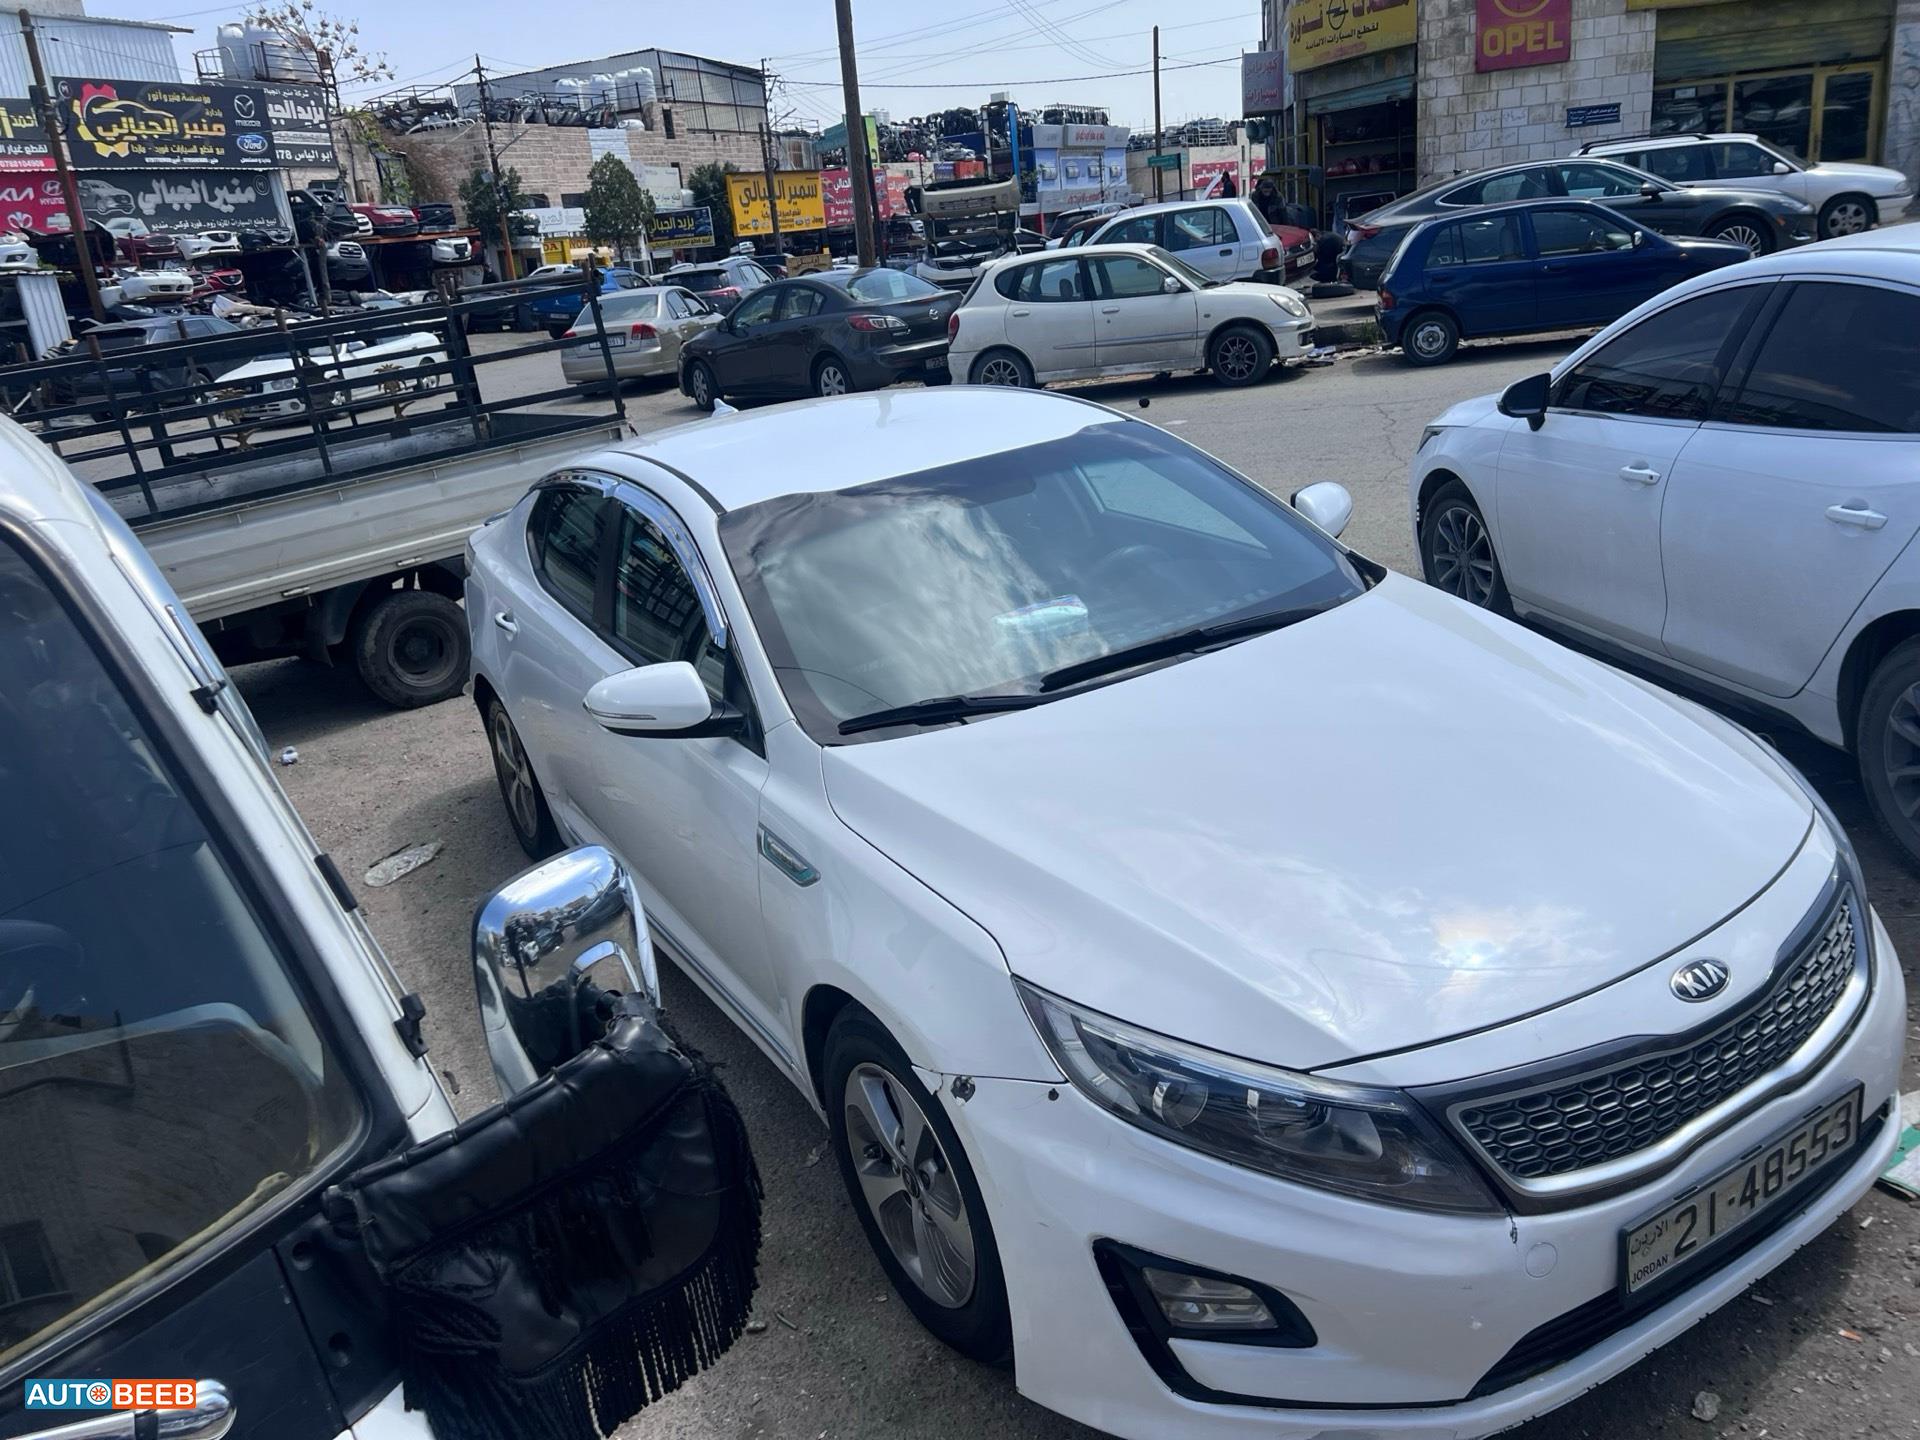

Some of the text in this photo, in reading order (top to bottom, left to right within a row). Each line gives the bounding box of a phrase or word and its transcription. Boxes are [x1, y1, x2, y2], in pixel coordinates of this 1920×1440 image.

[1482, 21, 1564, 57] OPEL
[96, 116, 226, 141] منير الجبالي
[297, 99, 327, 129] يزيد
[243, 138, 263, 150] Ford
[294, 149, 319, 162] الياس
[320, 150, 333, 163] ابو
[137, 177, 256, 216] منير الجبالي
[739, 178, 818, 215] سمير البالي
[677, 215, 696, 231] يزيد
[1679, 962, 1727, 997] KIA
[1631, 1254, 1669, 1285] JORDAN
